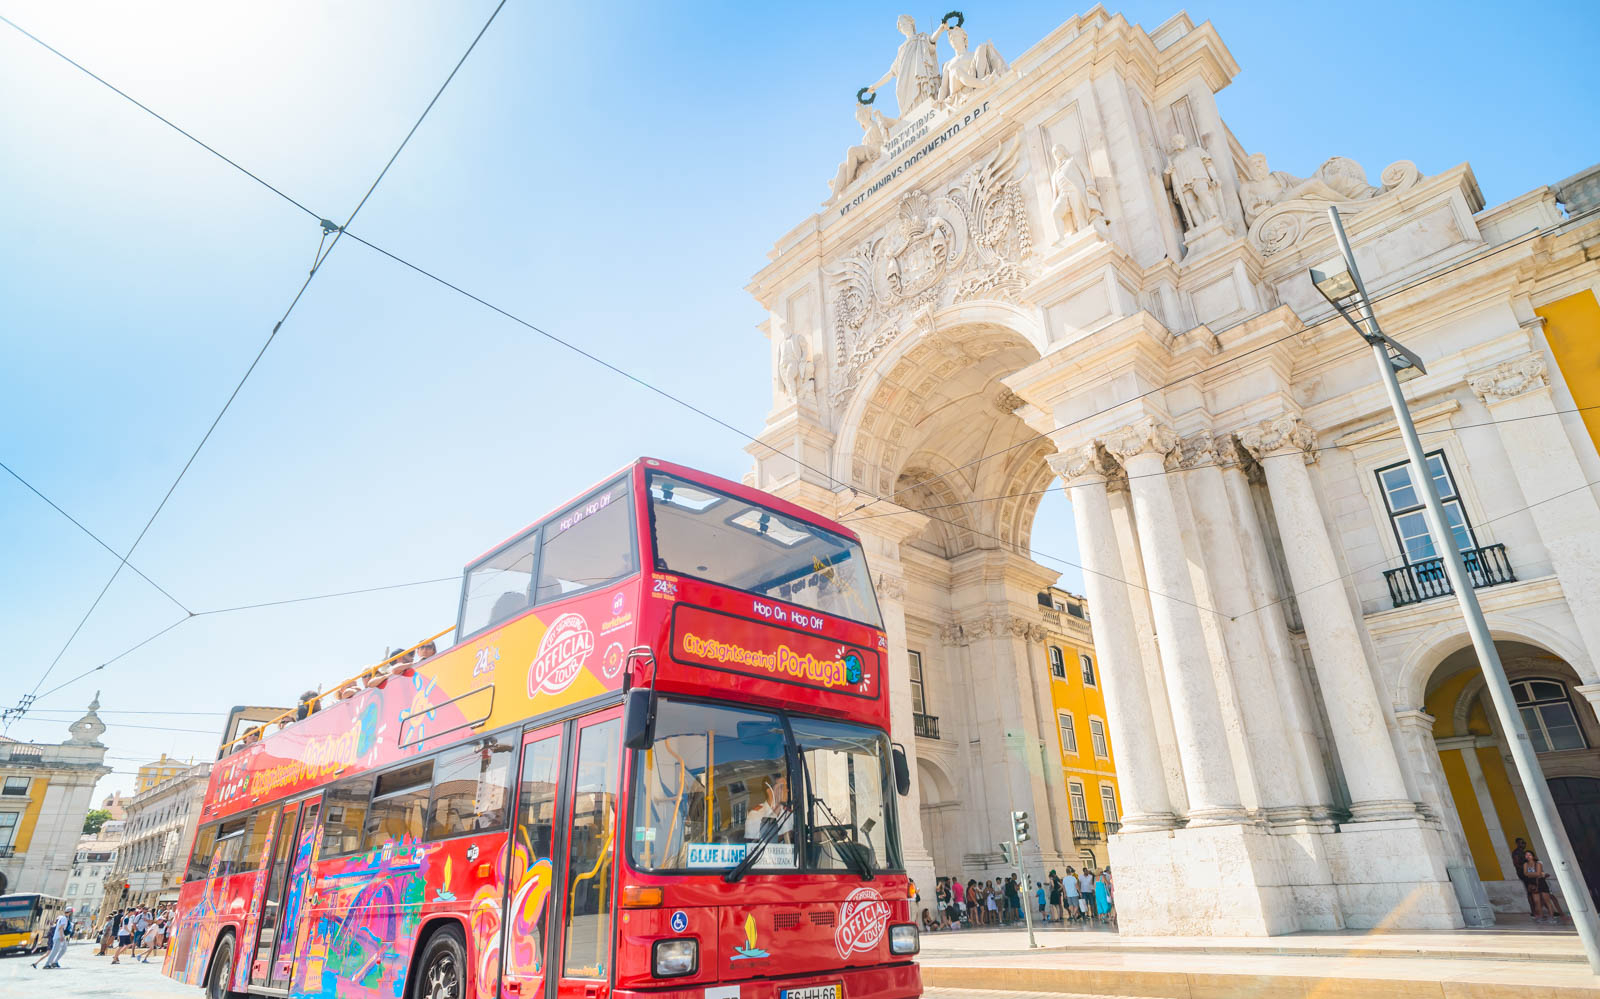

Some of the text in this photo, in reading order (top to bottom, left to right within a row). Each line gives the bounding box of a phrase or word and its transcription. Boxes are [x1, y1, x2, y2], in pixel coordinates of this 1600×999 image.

[853, 193, 865, 208] SIT
[753, 600, 824, 630] Hop On Hop Off
[536, 633, 591, 683] OFFICIAL
[554, 658, 578, 683] TOUR
[683, 633, 848, 688] CitySightseeing Portugal
[690, 848, 719, 863] BLUE
[721, 848, 746, 863] LINE
[843, 902, 888, 944] OFFICIAL
[863, 920, 883, 942] TOUR
